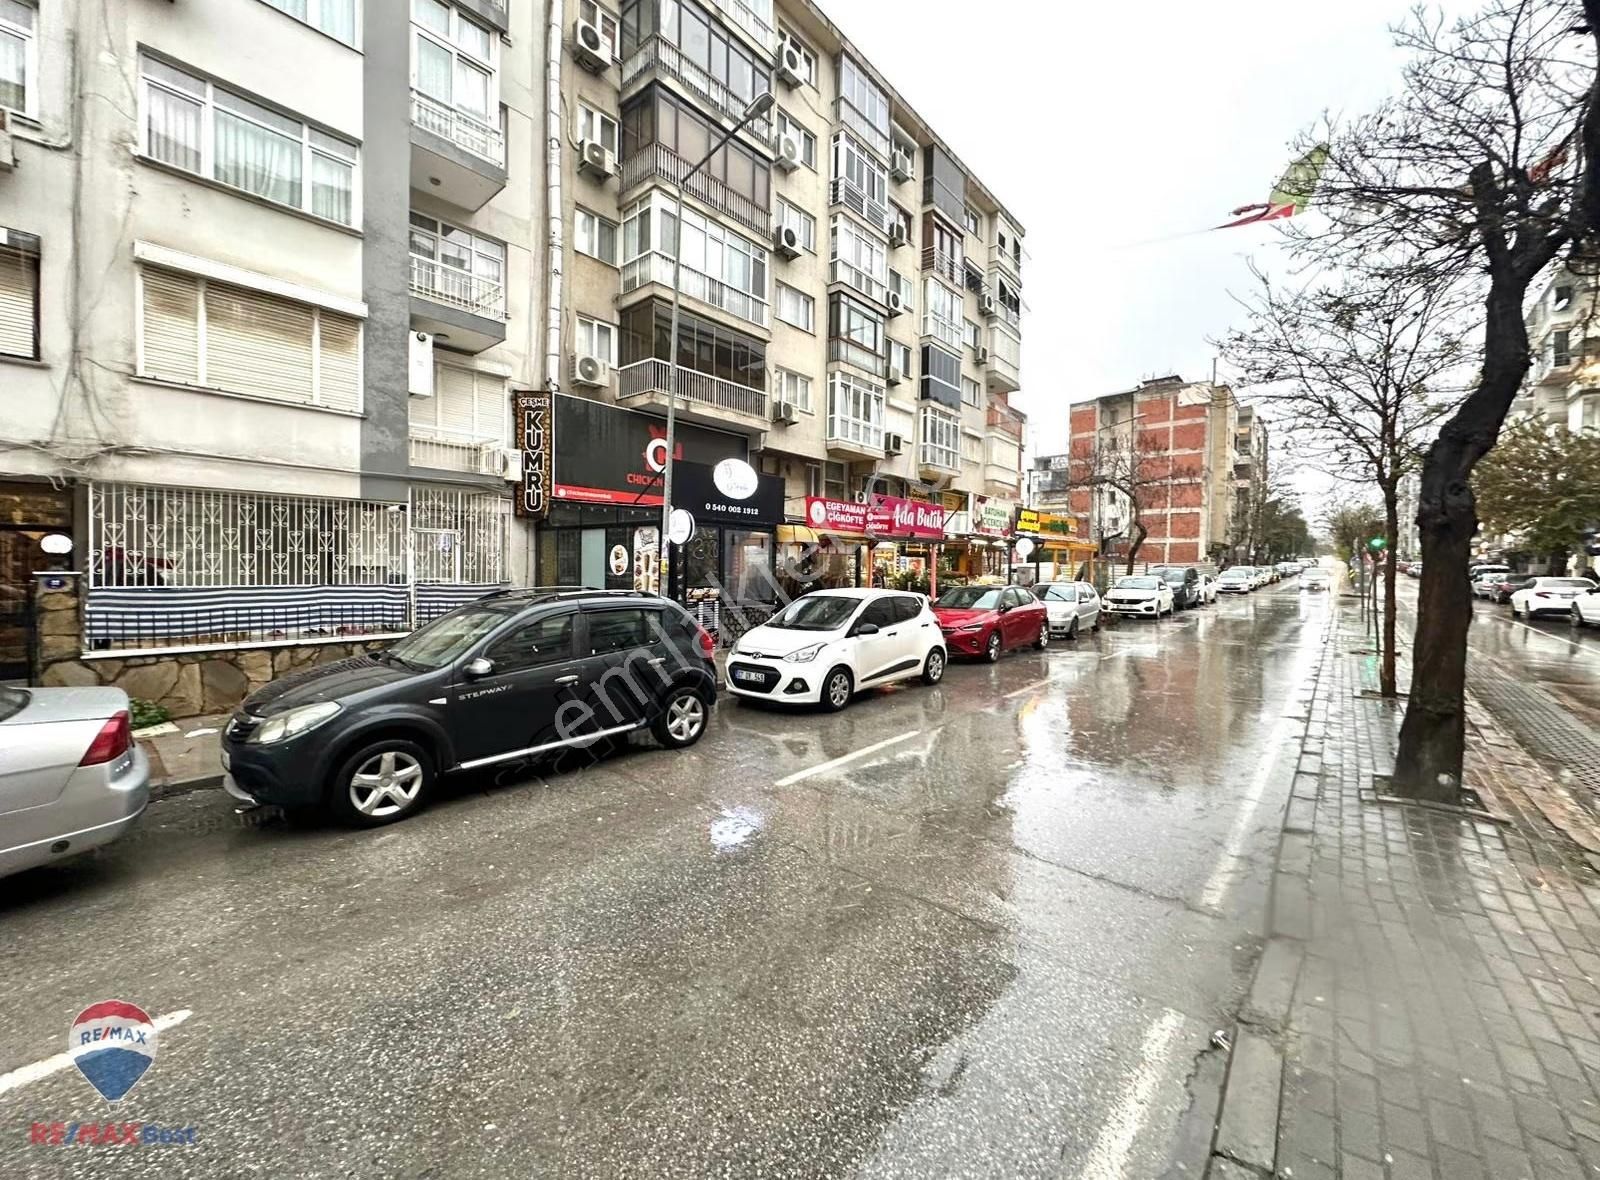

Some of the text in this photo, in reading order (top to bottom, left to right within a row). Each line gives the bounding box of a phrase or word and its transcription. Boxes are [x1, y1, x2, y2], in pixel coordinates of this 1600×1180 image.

[520, 397, 550, 408] ÇEŞME
[523, 411, 545, 512] KUMRU
[705, 502, 711, 510] 0
[712, 503, 727, 512] 540
[742, 507, 759, 515] 1912
[825, 501, 866, 515] EGEYAMAN
[893, 503, 943, 529] Ada Butik
[458, 684, 508, 701] STEPWAY
